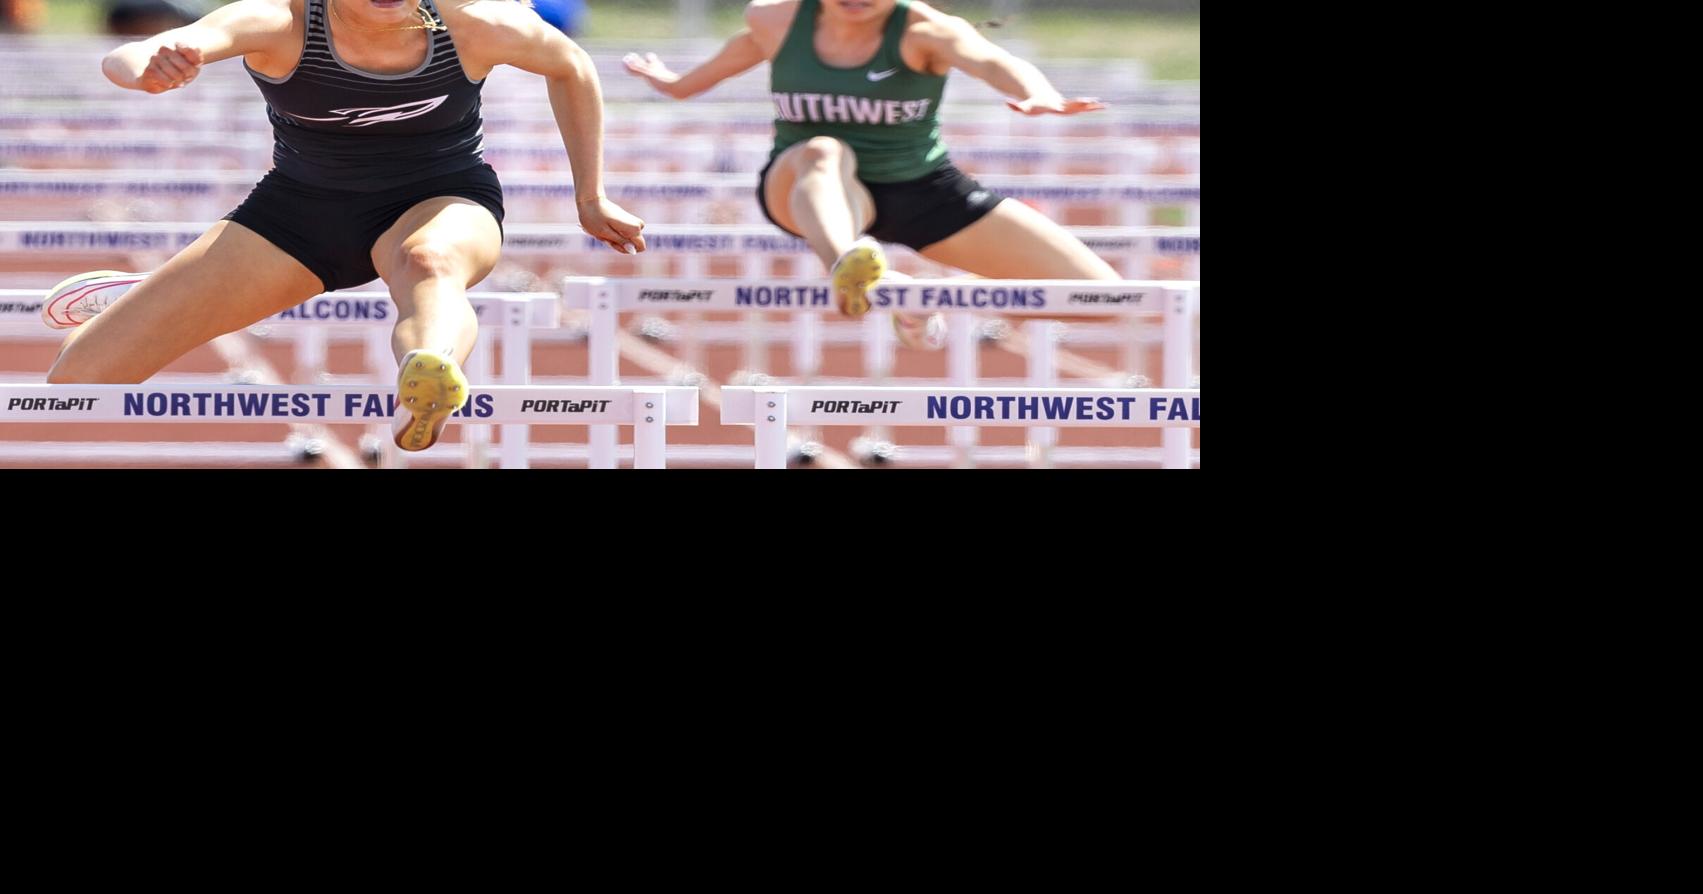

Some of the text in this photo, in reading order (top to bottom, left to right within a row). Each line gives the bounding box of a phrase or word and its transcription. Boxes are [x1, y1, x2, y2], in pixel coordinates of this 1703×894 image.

[735, 286, 909, 307] NORTHST
[921, 287, 1046, 308] FALCONS
[280, 299, 389, 320] ALCONS
[123, 393, 331, 417] NORTHWEST
[345, 393, 494, 418] FALNS
[927, 396, 1136, 420] NORTHWEST
